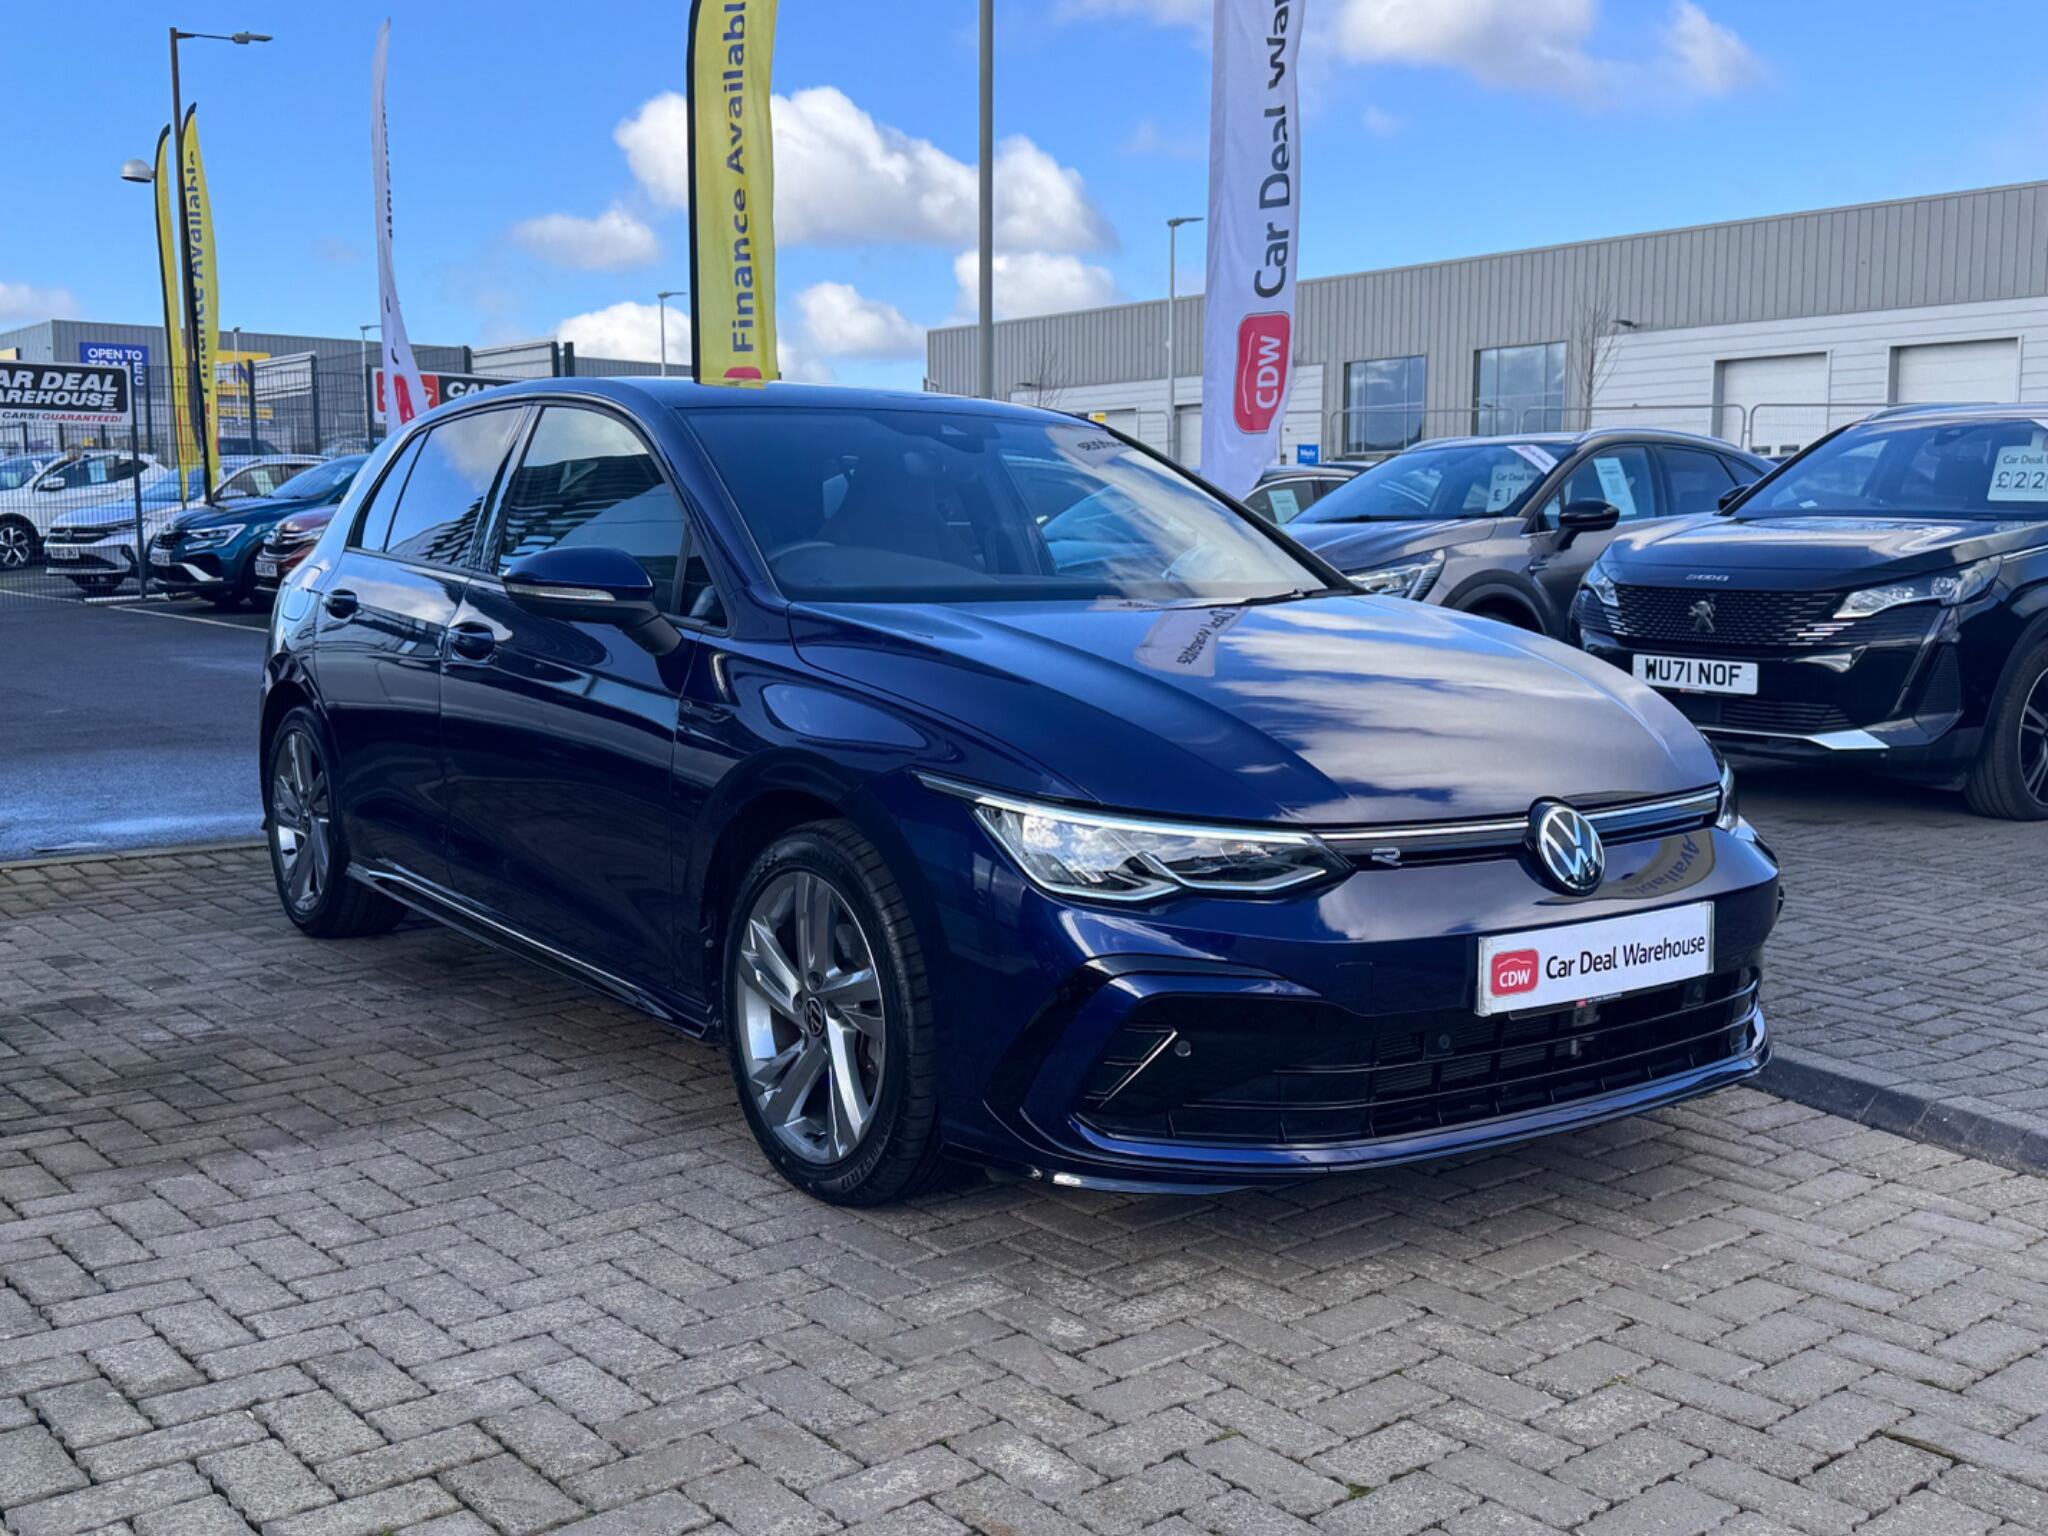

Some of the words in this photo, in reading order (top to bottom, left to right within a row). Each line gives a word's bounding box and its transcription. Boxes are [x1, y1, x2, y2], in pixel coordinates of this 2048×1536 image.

[1259, 105, 1291, 209] Deal
[732, 188, 754, 352] Finance
[1254, 222, 1289, 298] Car
[88, 347, 122, 360] OPEN
[125, 349, 143, 362] TO
[40, 371, 118, 392] DEAL
[1256, 335, 1281, 409] CDW
[2, 410, 40, 420] CARS!
[42, 412, 123, 423] GUARANTEED!
[2003, 454, 2019, 464] Car
[2021, 454, 2043, 464] Deal
[1645, 658, 1692, 684] WU71
[1698, 662, 1742, 687] NOF
[1545, 955, 1576, 980] Car
[1579, 946, 1617, 975] Deal
[1622, 935, 1706, 967] Warehouse
[1499, 968, 1531, 988] CDW
